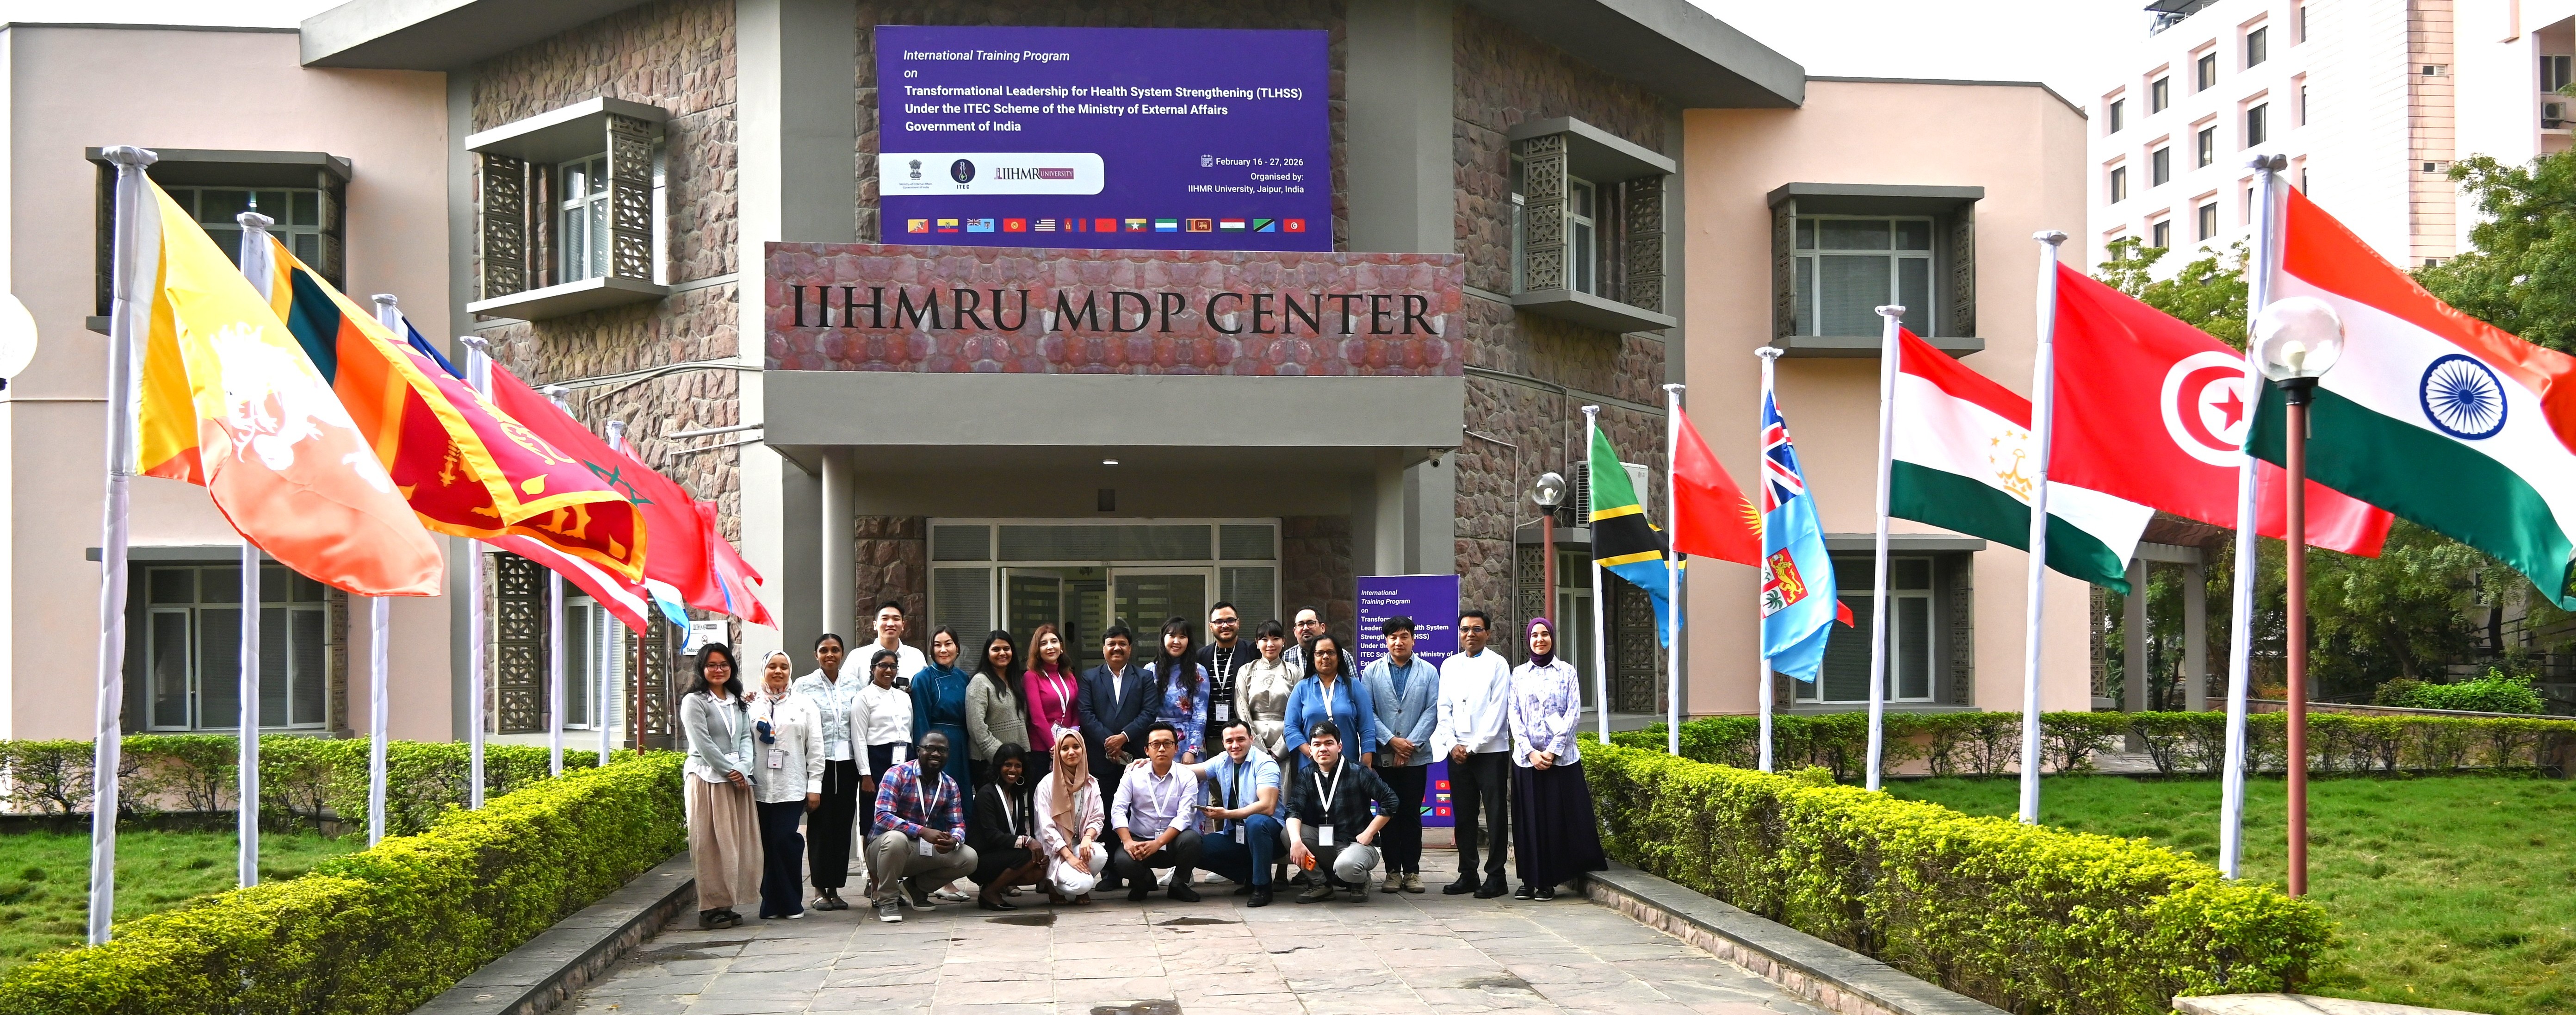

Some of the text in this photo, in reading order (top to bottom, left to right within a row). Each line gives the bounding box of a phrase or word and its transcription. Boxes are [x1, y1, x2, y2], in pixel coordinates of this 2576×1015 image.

[904, 50, 1070, 63] International Training Program
[904, 70, 918, 78] on
[904, 85, 1302, 101] Transformational Leadership for Health System Strengthening (TLHSS)
[905, 103, 1228, 117] Under the ITEC Scheme of the Ministry of External Affairs
[905, 120, 1021, 131] Government of India
[1216, 157, 1251, 167] February
[1269, 158, 1282, 167] 27,
[1003, 168, 1041, 180] IIHMR
[1251, 173, 1304, 182] Organised by:
[1214, 185, 1255, 194] University,
[1257, 185, 1283, 194] Jaipur,
[790, 285, 1440, 335] IIHMRU MDP CENTER
